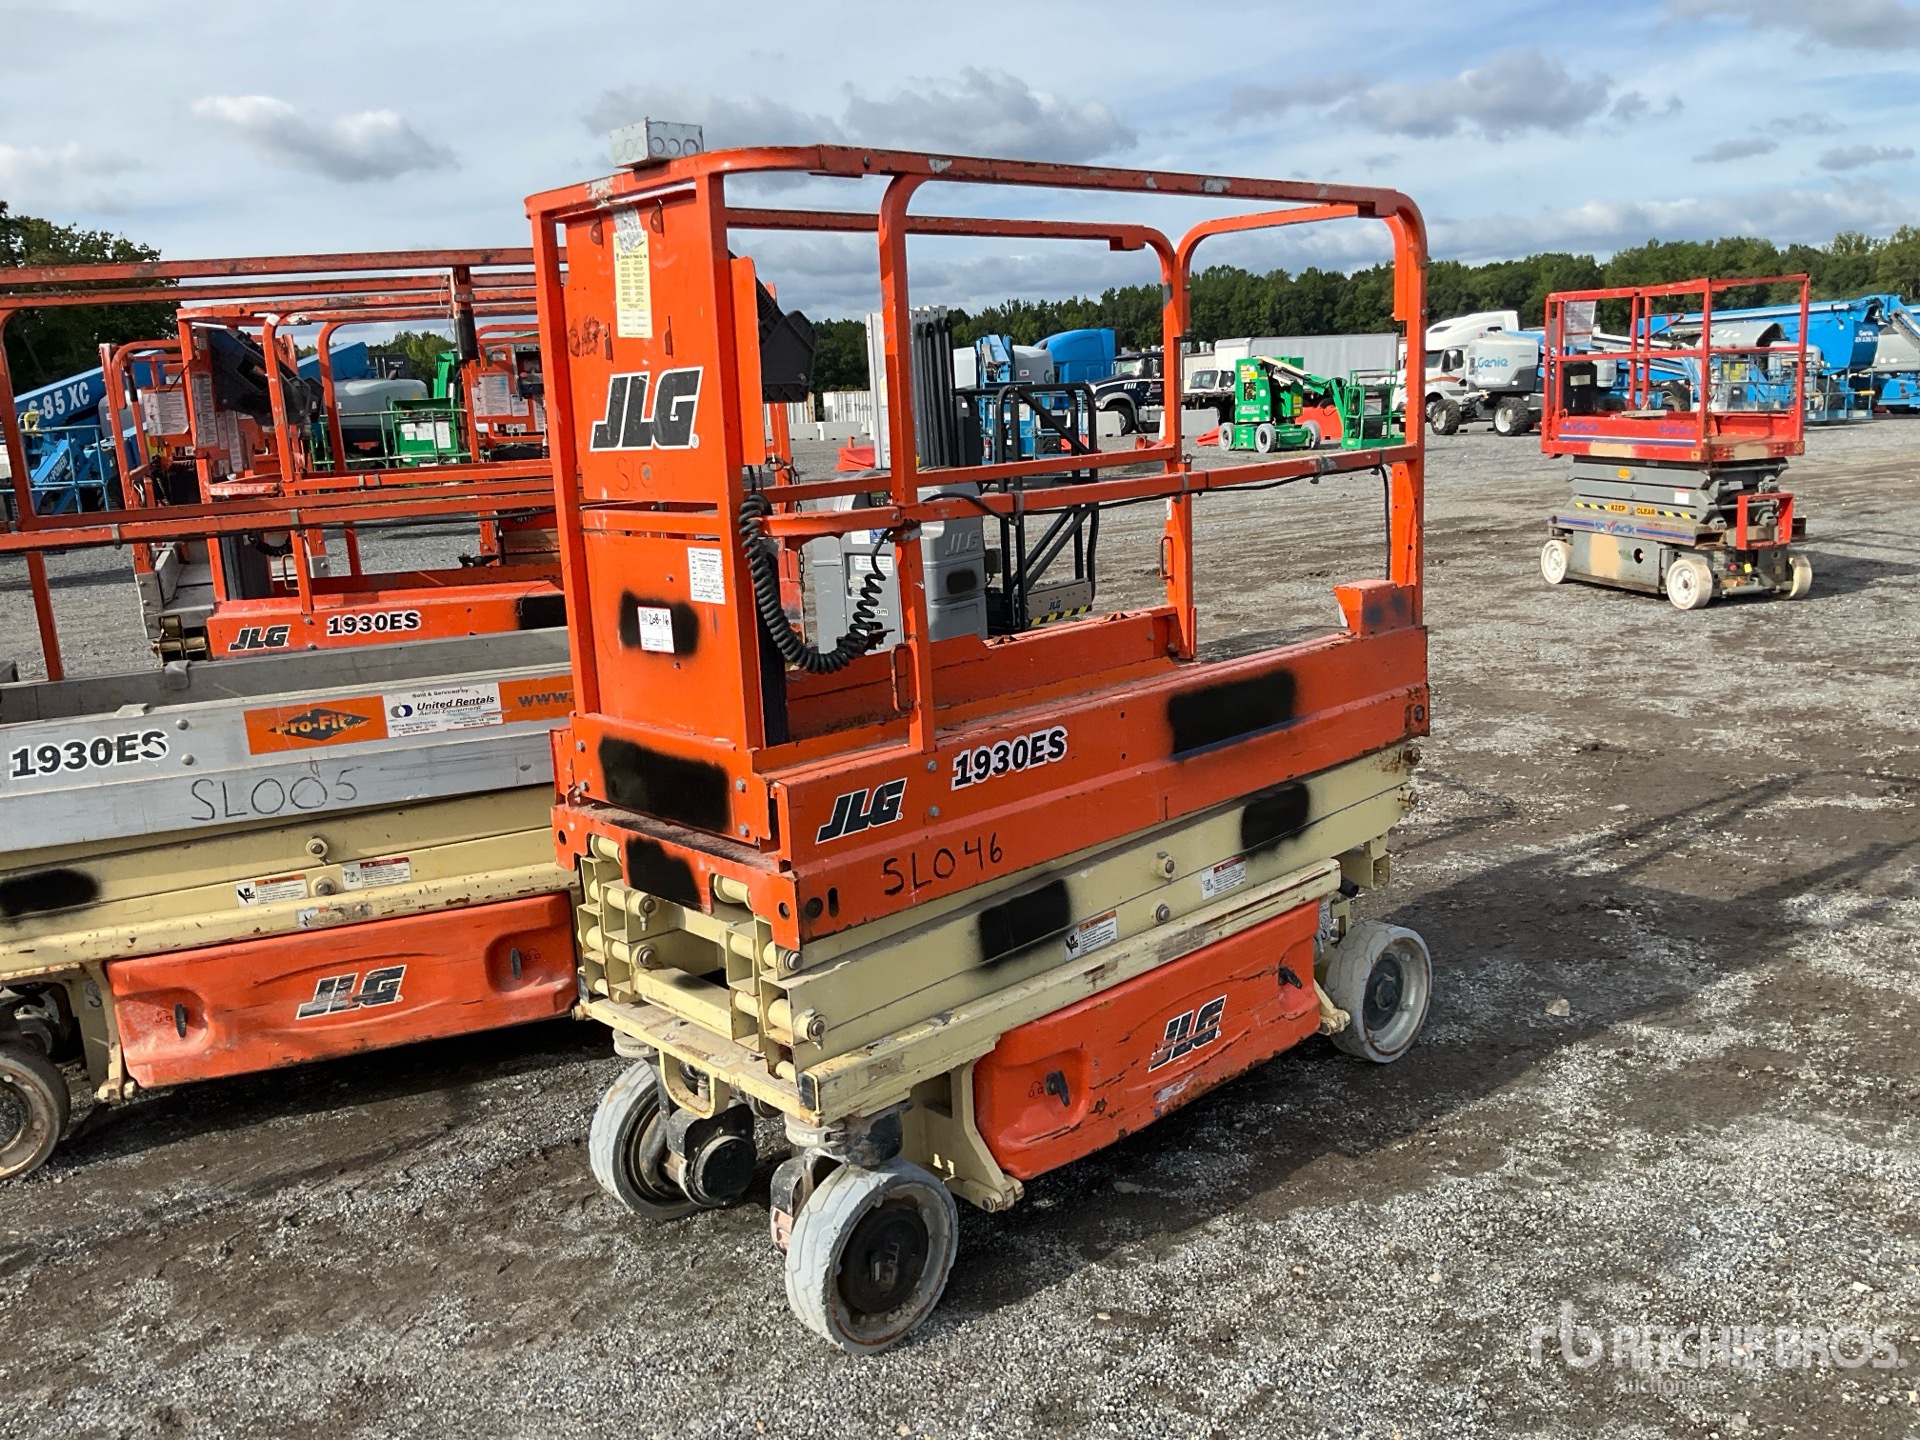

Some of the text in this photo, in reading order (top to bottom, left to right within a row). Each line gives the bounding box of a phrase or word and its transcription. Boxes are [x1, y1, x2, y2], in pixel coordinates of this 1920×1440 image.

[1476, 356, 1509, 368] Genie
[69, 381, 91, 411] XC
[589, 366, 704, 452] JLG
[1635, 507, 1656, 515] CLEAR
[944, 530, 981, 557] JLG
[228, 624, 291, 652] JLG
[327, 610, 422, 637] 1930ES
[416, 695, 495, 712] United Rentals
[275, 714, 346, 735] Pro-Fit
[9, 730, 169, 780] 1930ES
[951, 725, 1068, 791] 1930ES
[815, 777, 908, 845] JLG
[295, 964, 408, 1021] JLG
[1147, 994, 1228, 1073] JLG
